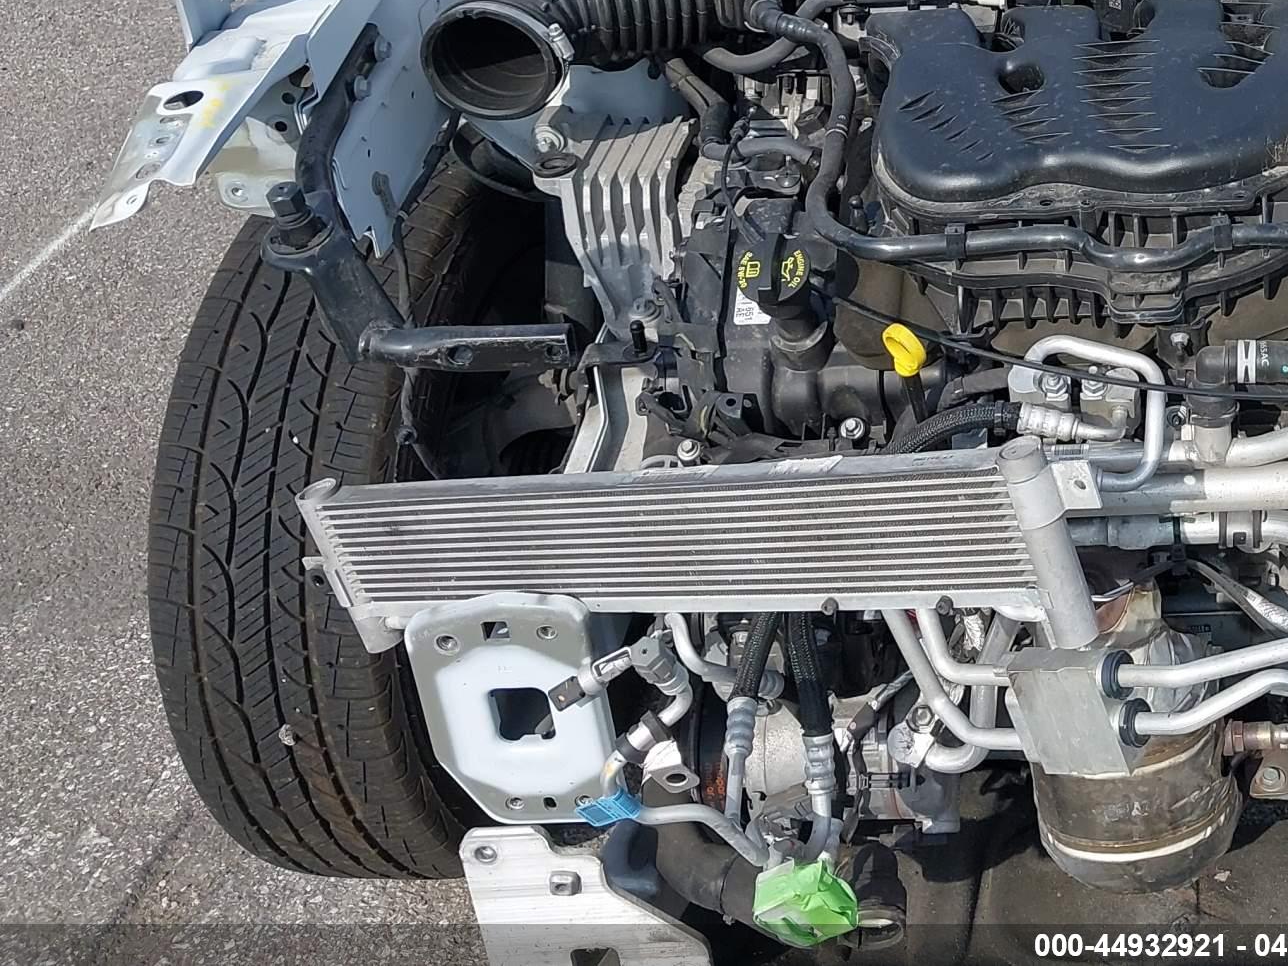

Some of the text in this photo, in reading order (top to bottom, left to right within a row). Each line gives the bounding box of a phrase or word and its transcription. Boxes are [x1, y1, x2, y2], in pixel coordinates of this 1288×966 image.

[740, 251, 753, 266] SAE
[787, 249, 806, 289] ENGINE OIL
